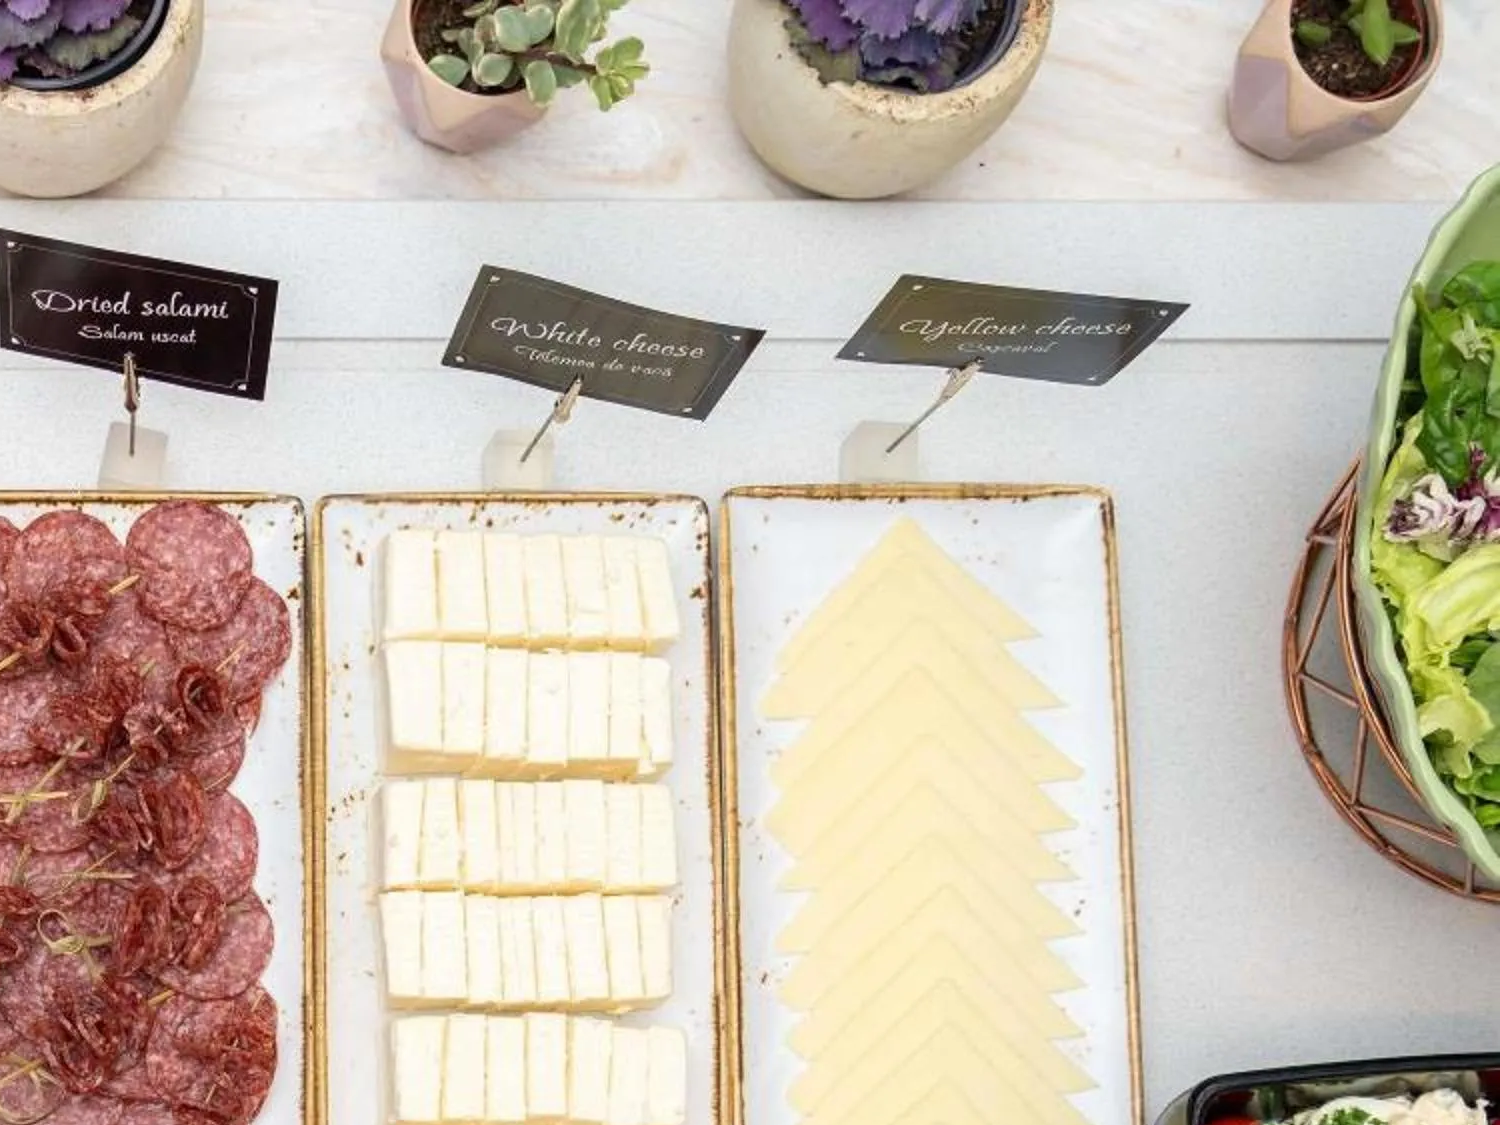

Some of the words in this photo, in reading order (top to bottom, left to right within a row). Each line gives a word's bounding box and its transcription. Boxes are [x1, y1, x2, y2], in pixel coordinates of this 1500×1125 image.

[31, 289, 131, 315] Dried
[141, 292, 229, 319] salami
[78, 324, 145, 342] Salam
[151, 328, 196, 343] uscat
[491, 317, 601, 347] White
[612, 329, 706, 359] cheese
[900, 317, 1029, 343] Yellow
[1036, 317, 1132, 336] cheese
